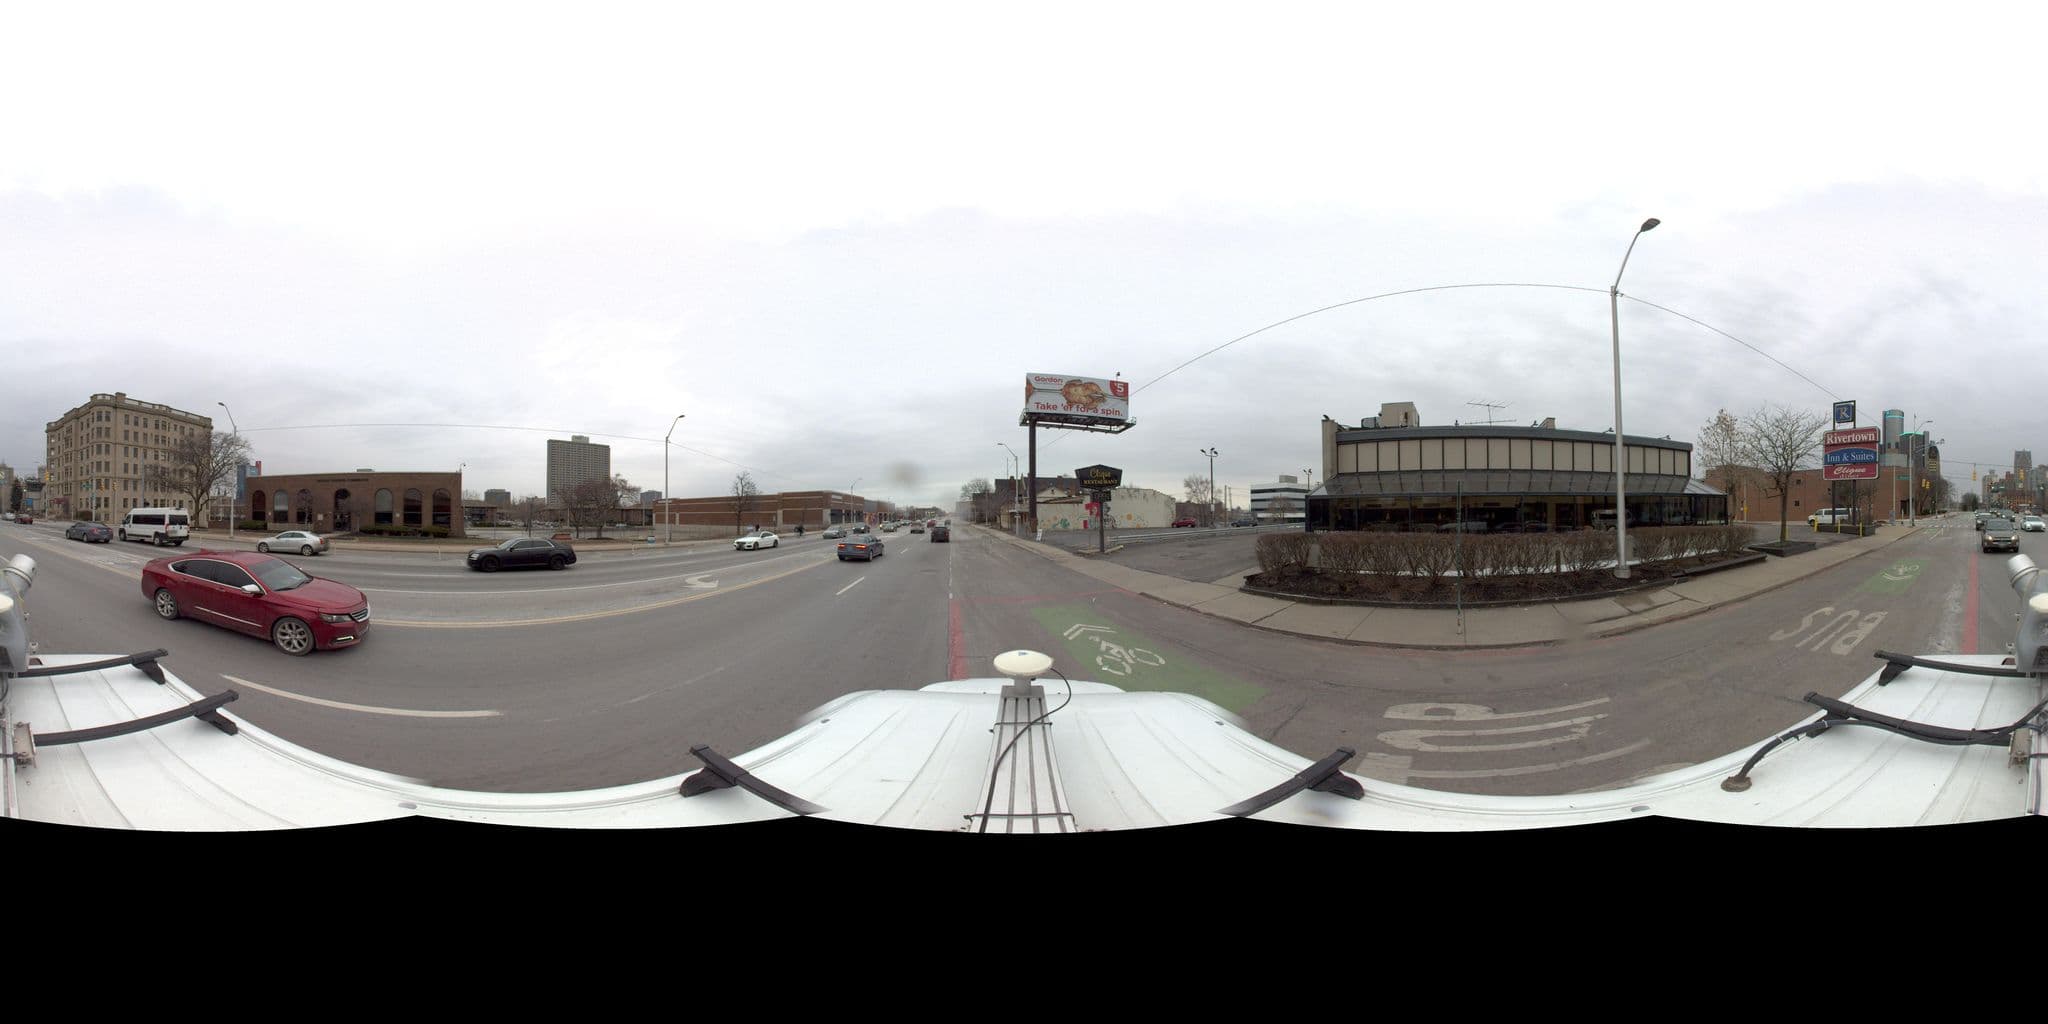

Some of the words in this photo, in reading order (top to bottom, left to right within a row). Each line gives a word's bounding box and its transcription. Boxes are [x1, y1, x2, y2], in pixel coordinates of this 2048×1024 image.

[1034, 375, 1063, 385] Gordon
[1034, 402, 1057, 411] Take
[1076, 404, 1090, 413] for
[1100, 408, 1123, 417] spin.
[1839, 407, 1849, 419] R
[1826, 432, 1875, 444] Rivertown
[1827, 454, 1840, 462] Inn
[1842, 453, 1849, 462] &
[1851, 452, 1874, 461] Suites
[1833, 466, 1866, 475] Clique
[1768, 607, 1888, 655] BUS
[1356, 698, 1682, 791] TOP
